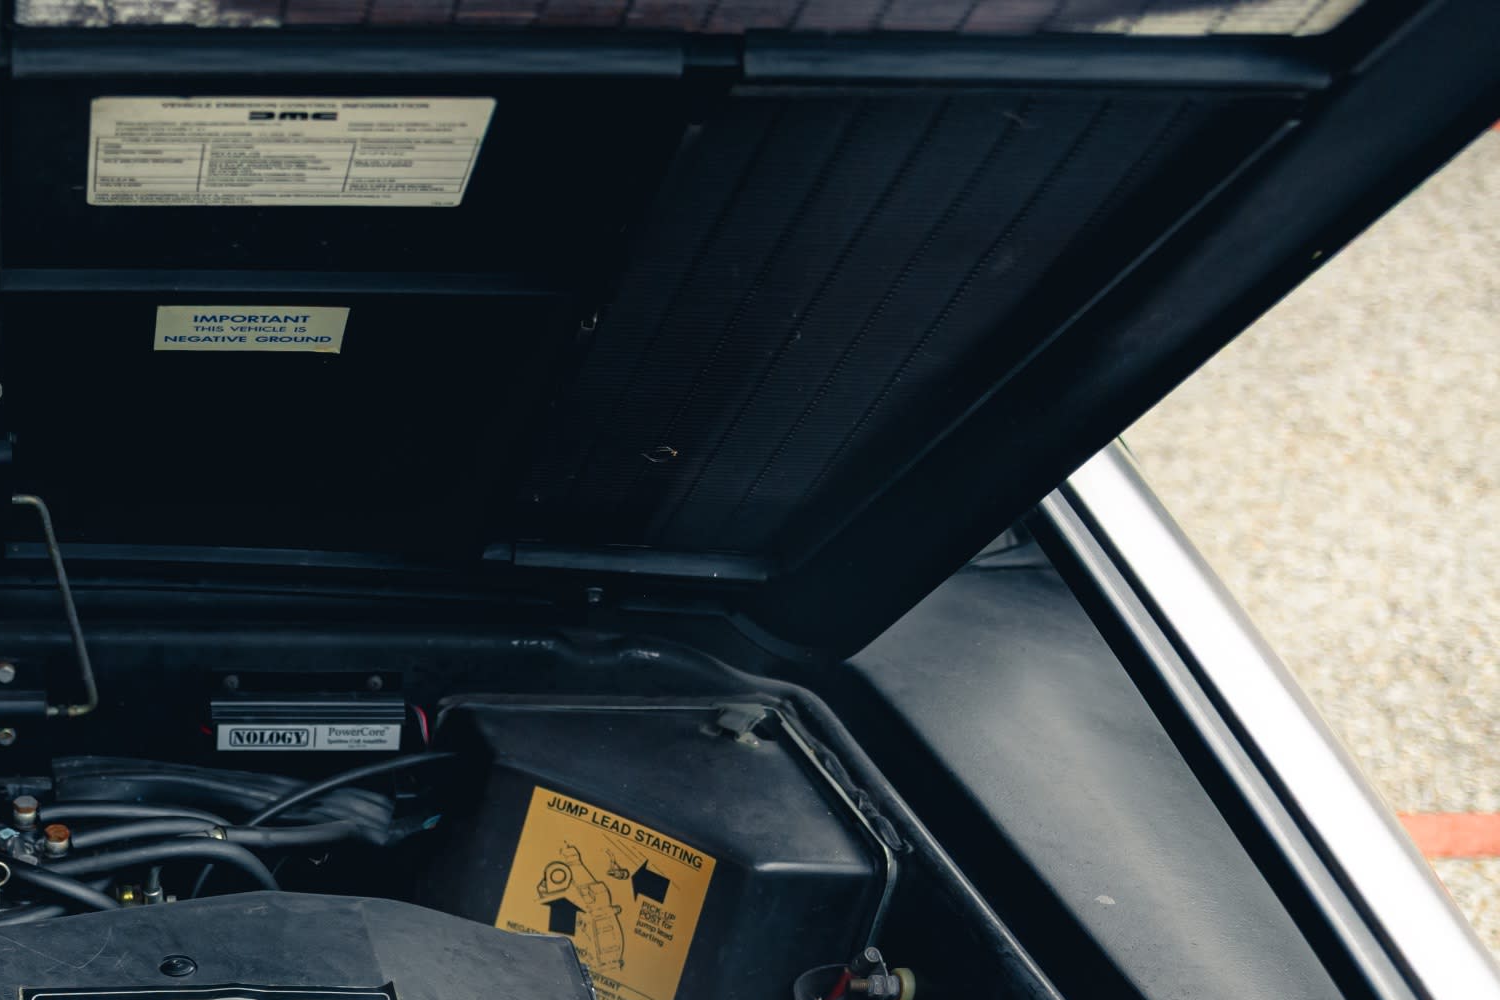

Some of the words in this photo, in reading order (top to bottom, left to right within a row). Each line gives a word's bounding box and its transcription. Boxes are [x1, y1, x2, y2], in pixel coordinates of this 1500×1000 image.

[193, 315, 311, 324] IMPORTANT
[194, 325, 224, 333] THIS
[231, 325, 287, 333] VEHICLE
[164, 335, 248, 343] NEGATIVE
[255, 335, 332, 343] GROUND
[232, 731, 306, 745] NOLOGY
[547, 796, 588, 818] JUMP
[592, 811, 631, 836] LEAD
[634, 829, 704, 869] STARTING
